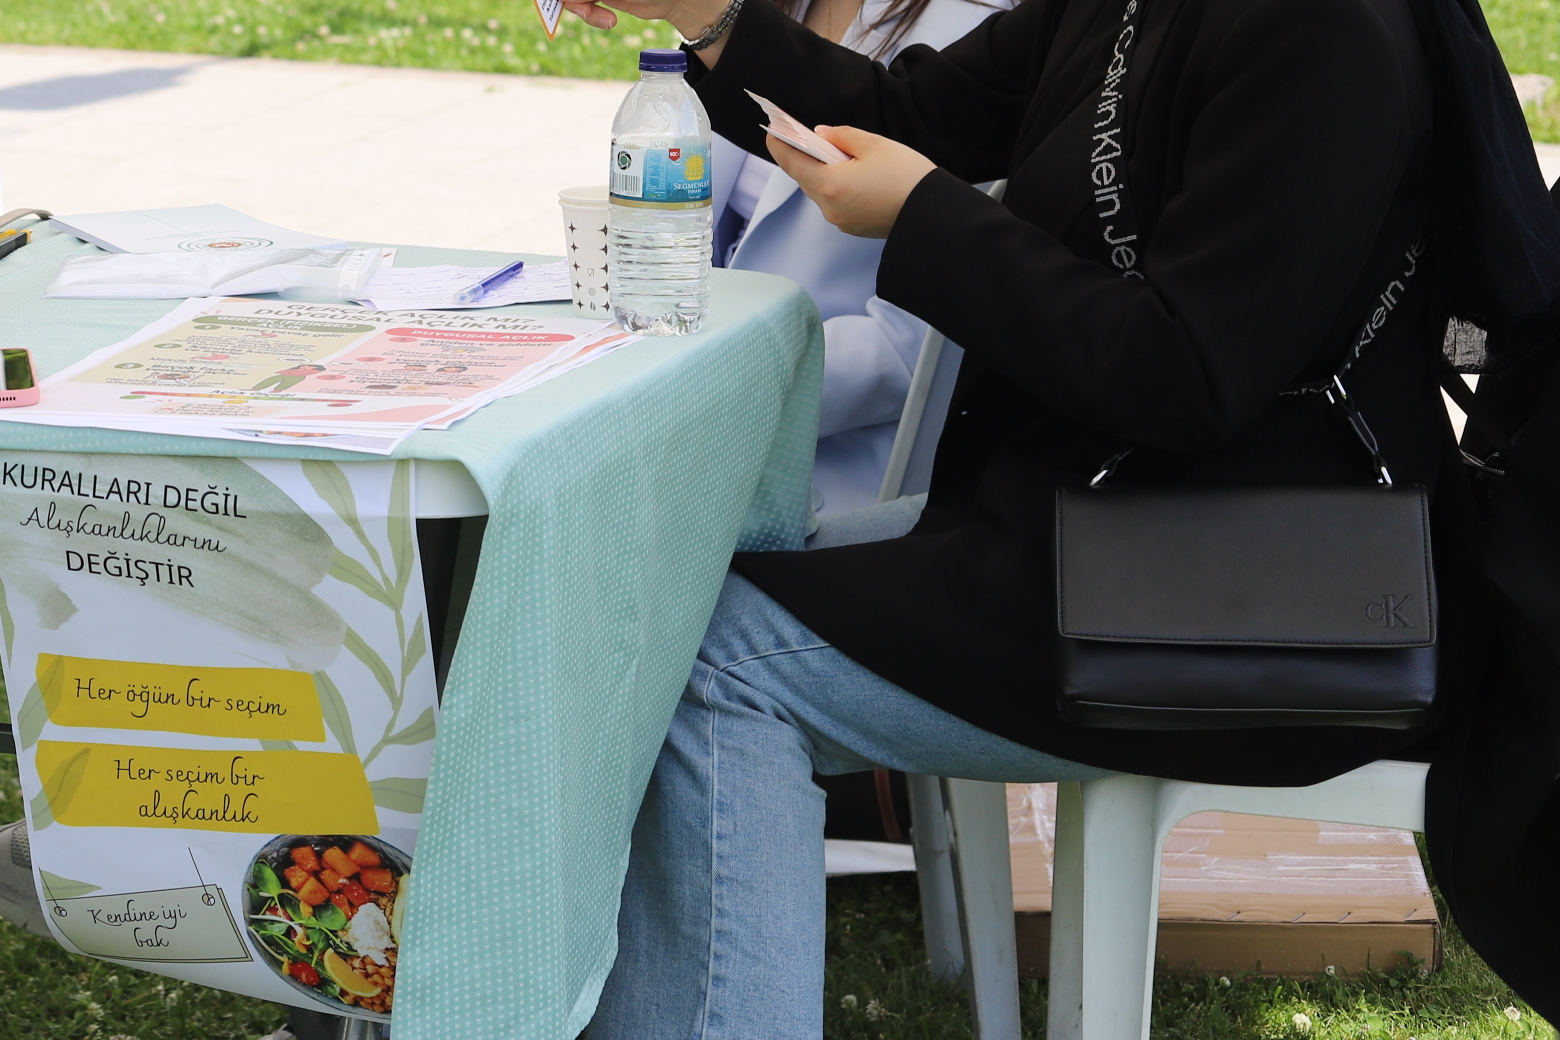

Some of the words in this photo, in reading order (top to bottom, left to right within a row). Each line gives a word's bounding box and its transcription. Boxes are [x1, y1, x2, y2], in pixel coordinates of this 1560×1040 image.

[2, 462, 153, 507] KURALLARI
[163, 485, 247, 519] DEĞİL
[19, 501, 228, 554] Alışkanlıklarını
[65, 549, 195, 589] DEĞİŞTİR
[74, 678, 121, 702] Her
[126, 684, 181, 718] öğün
[185, 678, 221, 709] bir
[225, 696, 287, 719] seçim
[113, 759, 161, 782] Her
[165, 765, 225, 789] seçim
[229, 756, 265, 787] bir
[138, 789, 259, 826] alışkanlık
[87, 899, 160, 927] Kendine
[162, 904, 188, 929] iyi
[133, 925, 170, 948] bak
